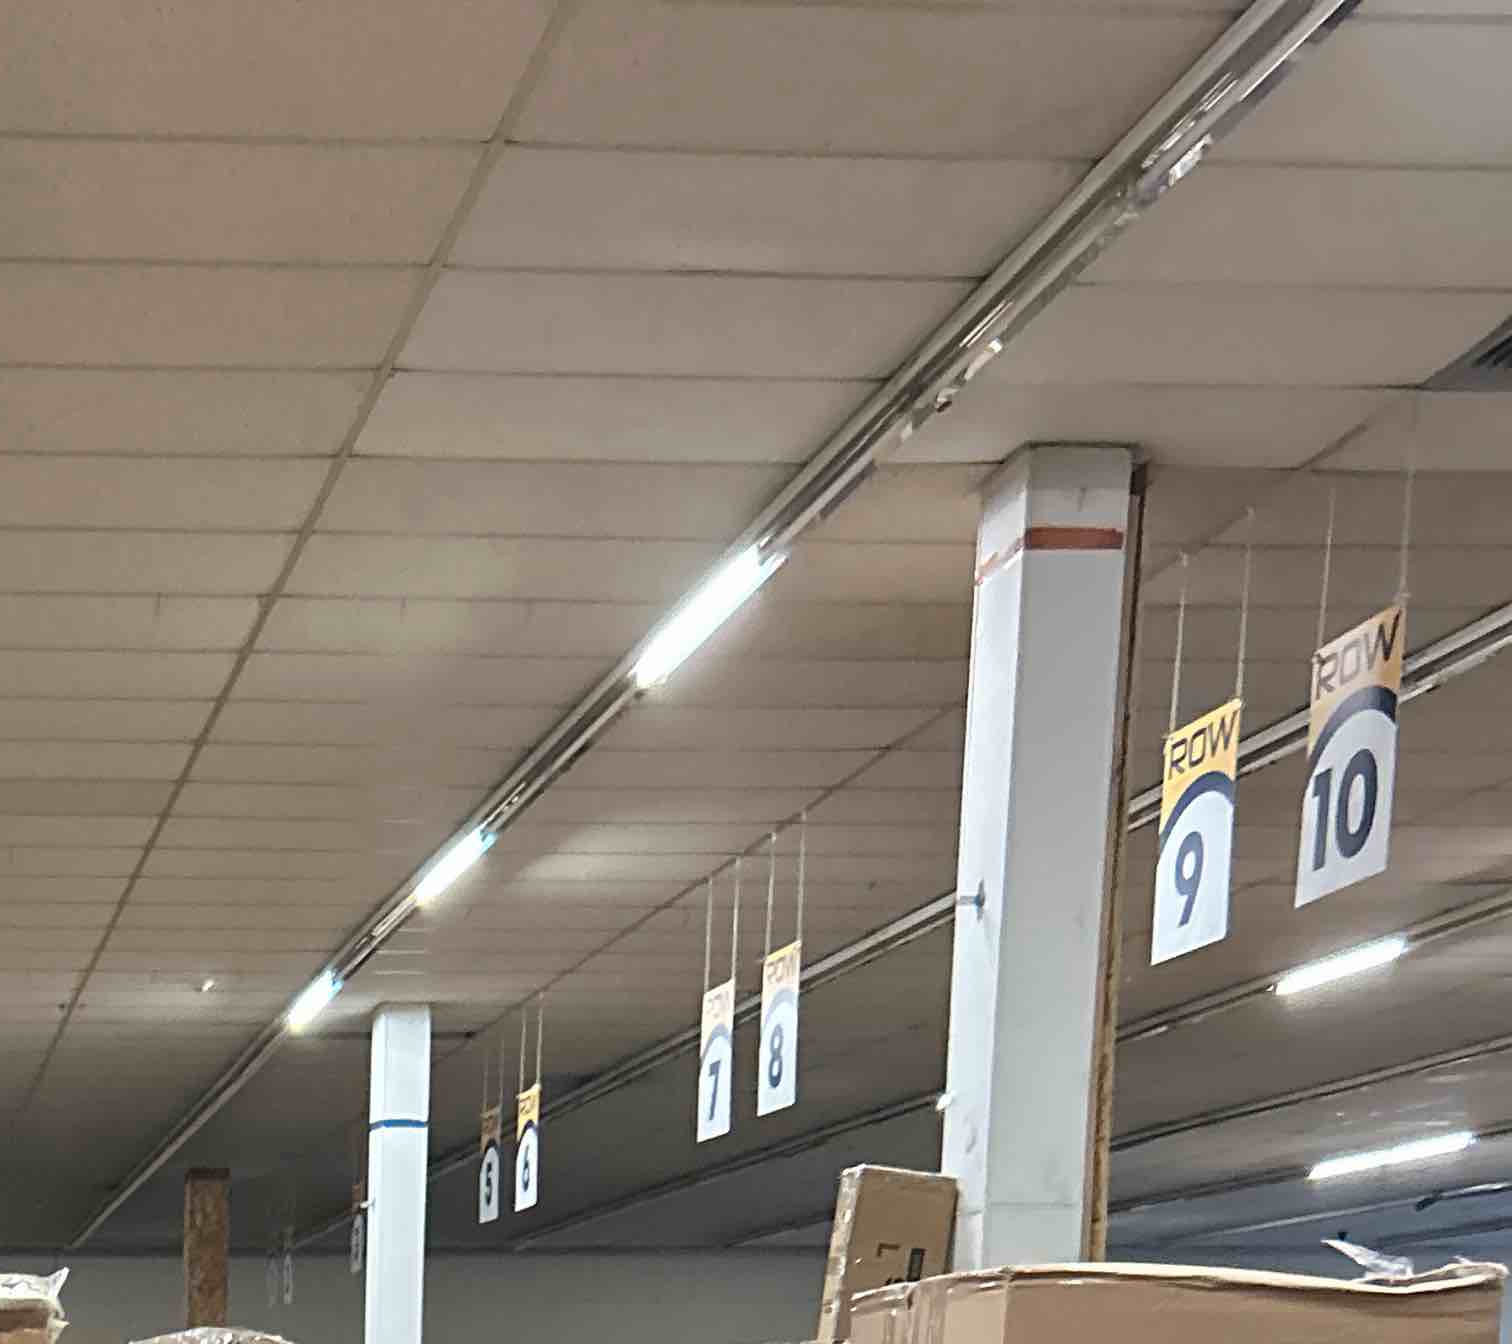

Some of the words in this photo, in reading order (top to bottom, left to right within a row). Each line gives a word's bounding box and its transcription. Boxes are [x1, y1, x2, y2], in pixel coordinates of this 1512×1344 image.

[1316, 611, 1400, 692] ROW
[1168, 711, 1237, 780] ROW
[1312, 749, 1378, 871] 10
[1175, 831, 1204, 928] 9
[769, 1024, 784, 1088] 8
[486, 1162, 493, 1206] 5
[522, 1146, 530, 1192] 6
